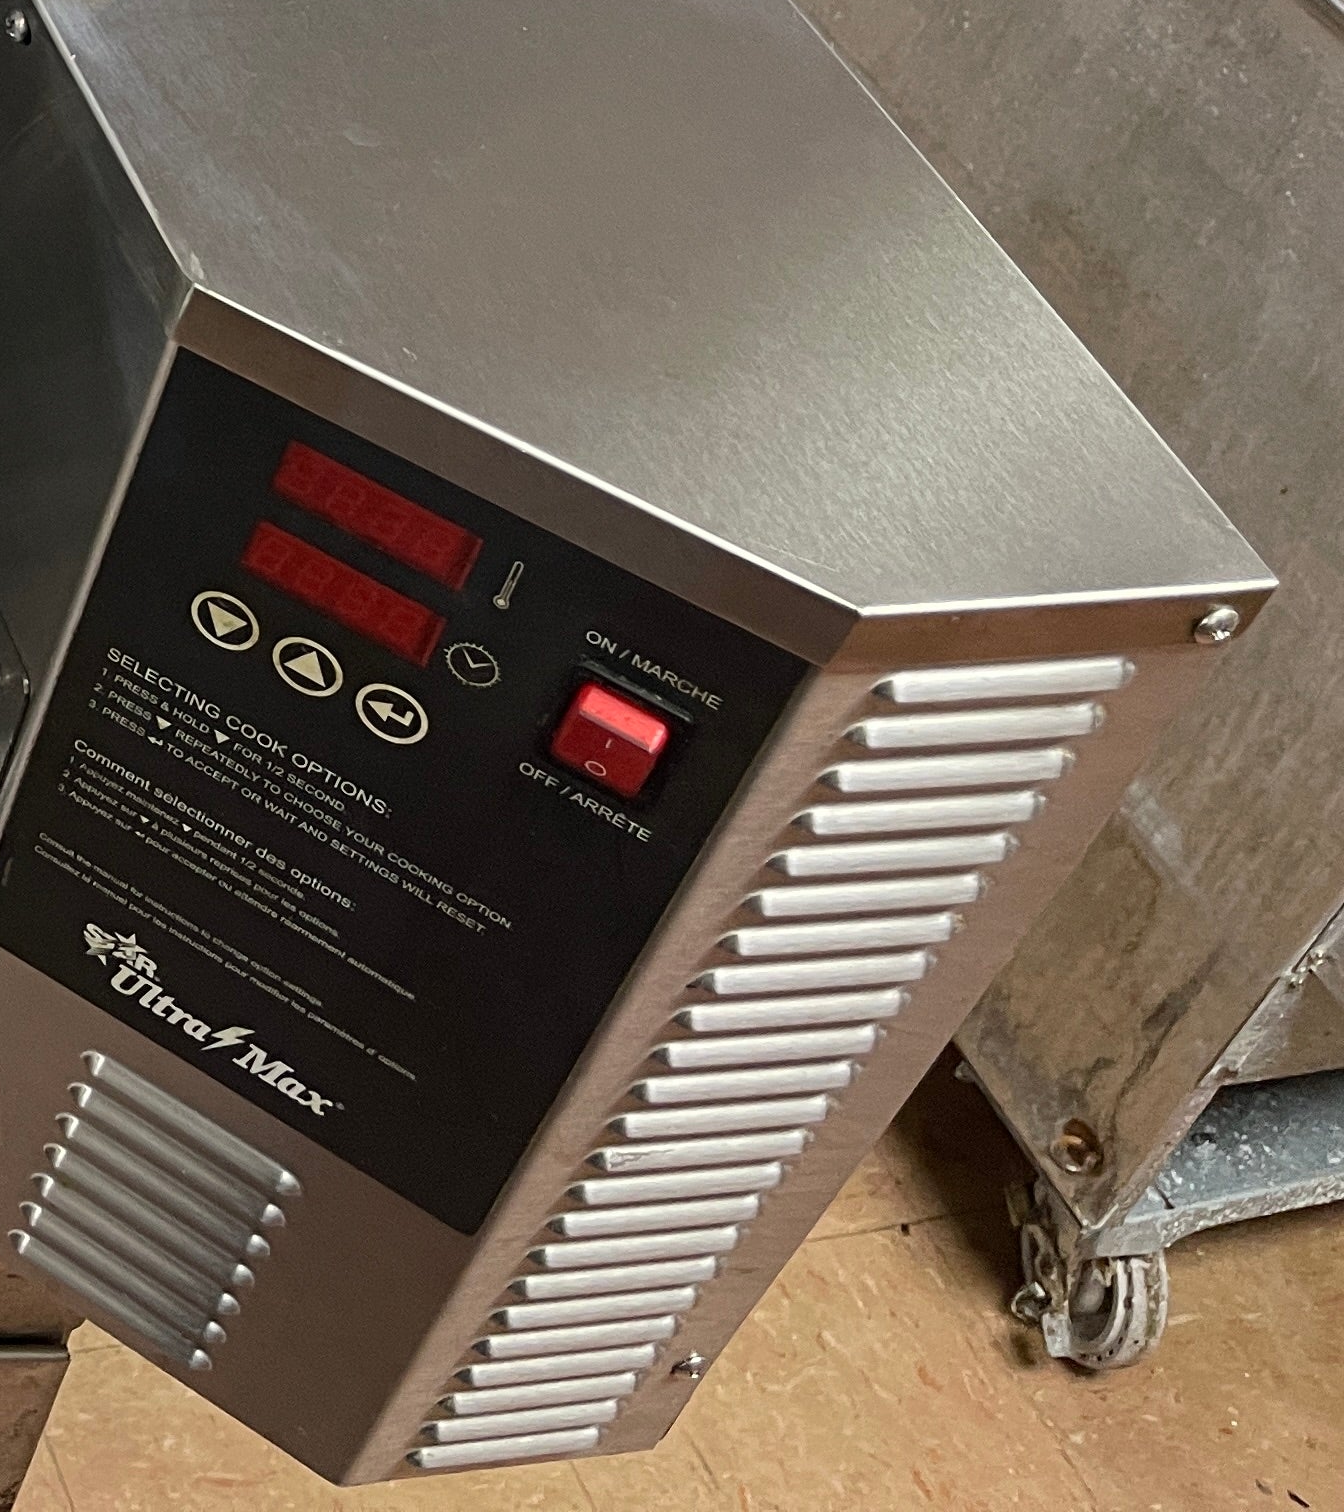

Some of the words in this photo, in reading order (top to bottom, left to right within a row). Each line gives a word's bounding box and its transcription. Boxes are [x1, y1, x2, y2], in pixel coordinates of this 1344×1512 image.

[107, 647, 221, 720] SELECTING
[225, 715, 288, 758] COOK
[291, 753, 393, 820] OPTIONS:
[114, 674, 159, 705] PRESS
[160, 699, 170, 712] &
[172, 707, 210, 734] HOLD
[233, 742, 263, 765] FOR
[266, 760, 285, 778] 1/2
[586, 630, 617, 654] ON
[631, 654, 724, 711] MARCHE
[74, 739, 151, 791] Comment
[153, 786, 253, 849] sélectionner
[255, 846, 286, 871] des
[290, 867, 356, 913] options:
[101, 706, 146, 737] PRESS
[166, 743, 185, 759] TO
[184, 755, 240, 790] ACCEPT
[240, 787, 262, 805] OR
[264, 799, 298, 824] WAIT
[298, 821, 328, 842] AND
[329, 838, 400, 884] SETTINGS
[402, 879, 435, 906] WILL
[107, 690, 152, 721] PRESS
[174, 728, 260, 783] REPEATEDLY
[263, 778, 282, 795] TO
[283, 792, 342, 831] CHOOSE
[345, 825, 385, 856] YOUR
[387, 852, 454, 895] COOKING
[519, 761, 560, 788] OFF
[569, 792, 653, 842] ARRÊTE
[111, 964, 212, 1043] Ultra
[232, 1043, 334, 1117] Max
